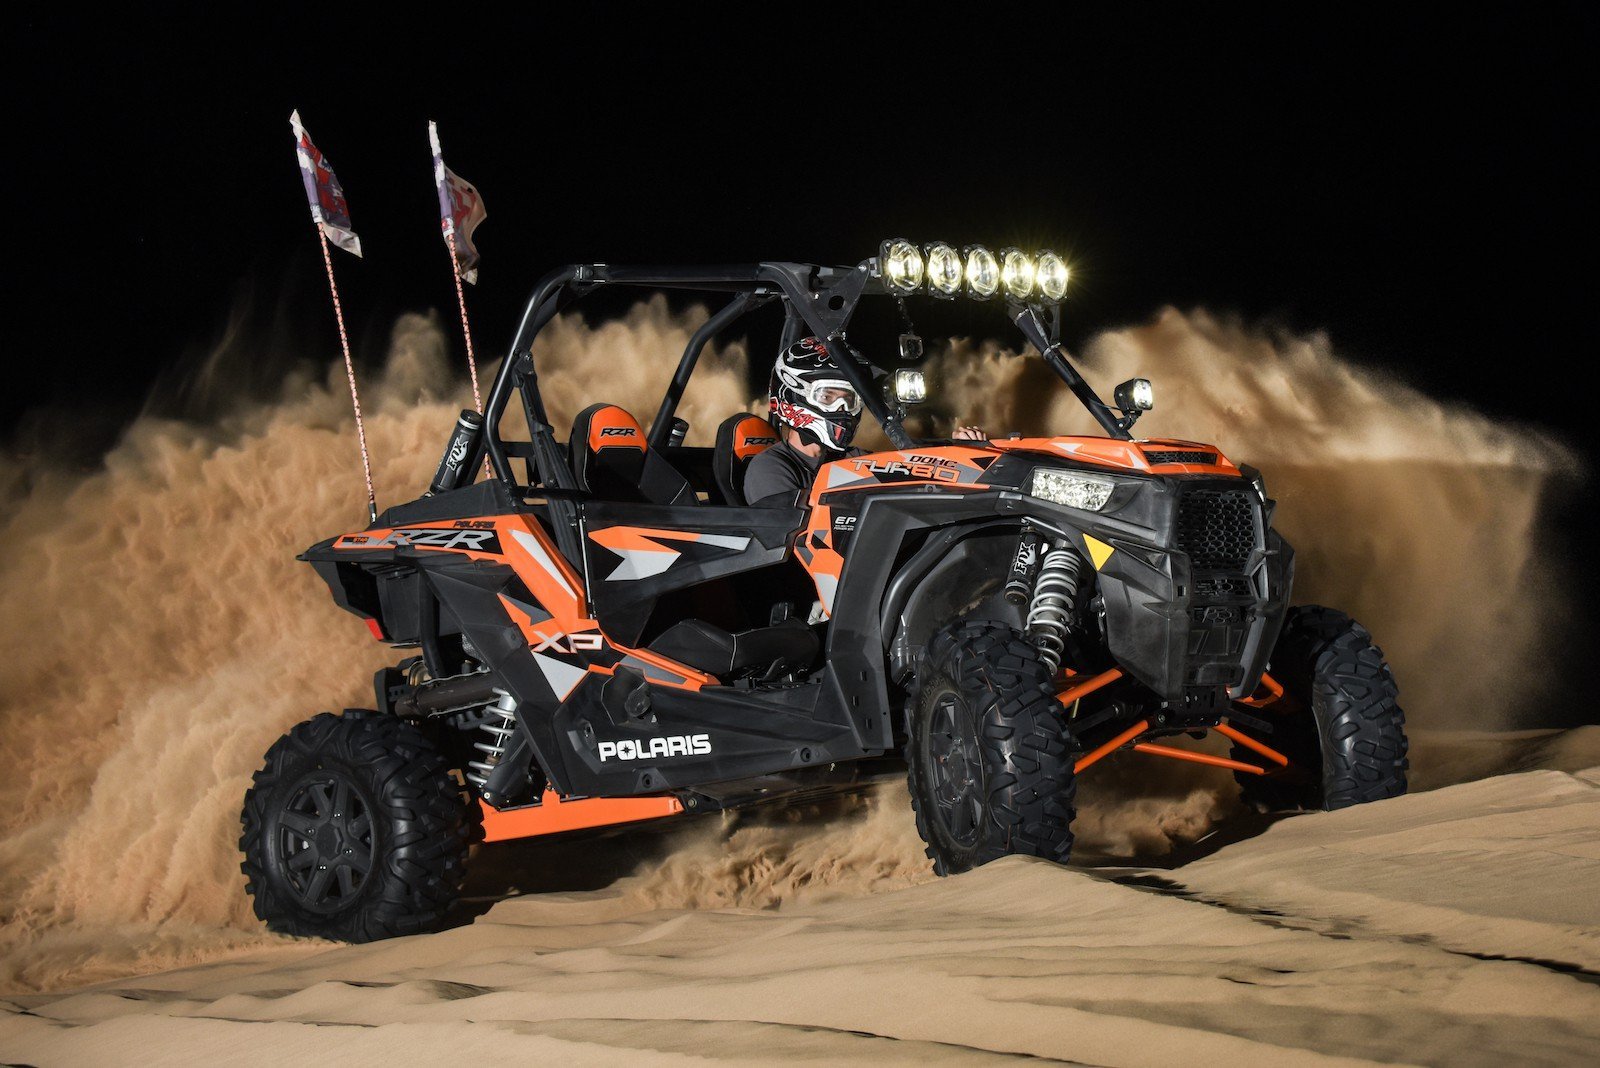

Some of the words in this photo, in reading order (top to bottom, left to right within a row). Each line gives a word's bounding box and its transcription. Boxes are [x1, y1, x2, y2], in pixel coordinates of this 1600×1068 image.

[601, 428, 636, 437] RZR
[744, 437, 776, 447] RZR
[446, 437, 469, 471] FOX
[909, 455, 958, 468] DOHC
[851, 459, 961, 483] TURBO
[453, 521, 496, 529] POLARIS
[384, 529, 494, 550] RZR
[1014, 541, 1036, 575] FOX
[530, 630, 603, 654] XP
[598, 734, 712, 762] POLARIS
